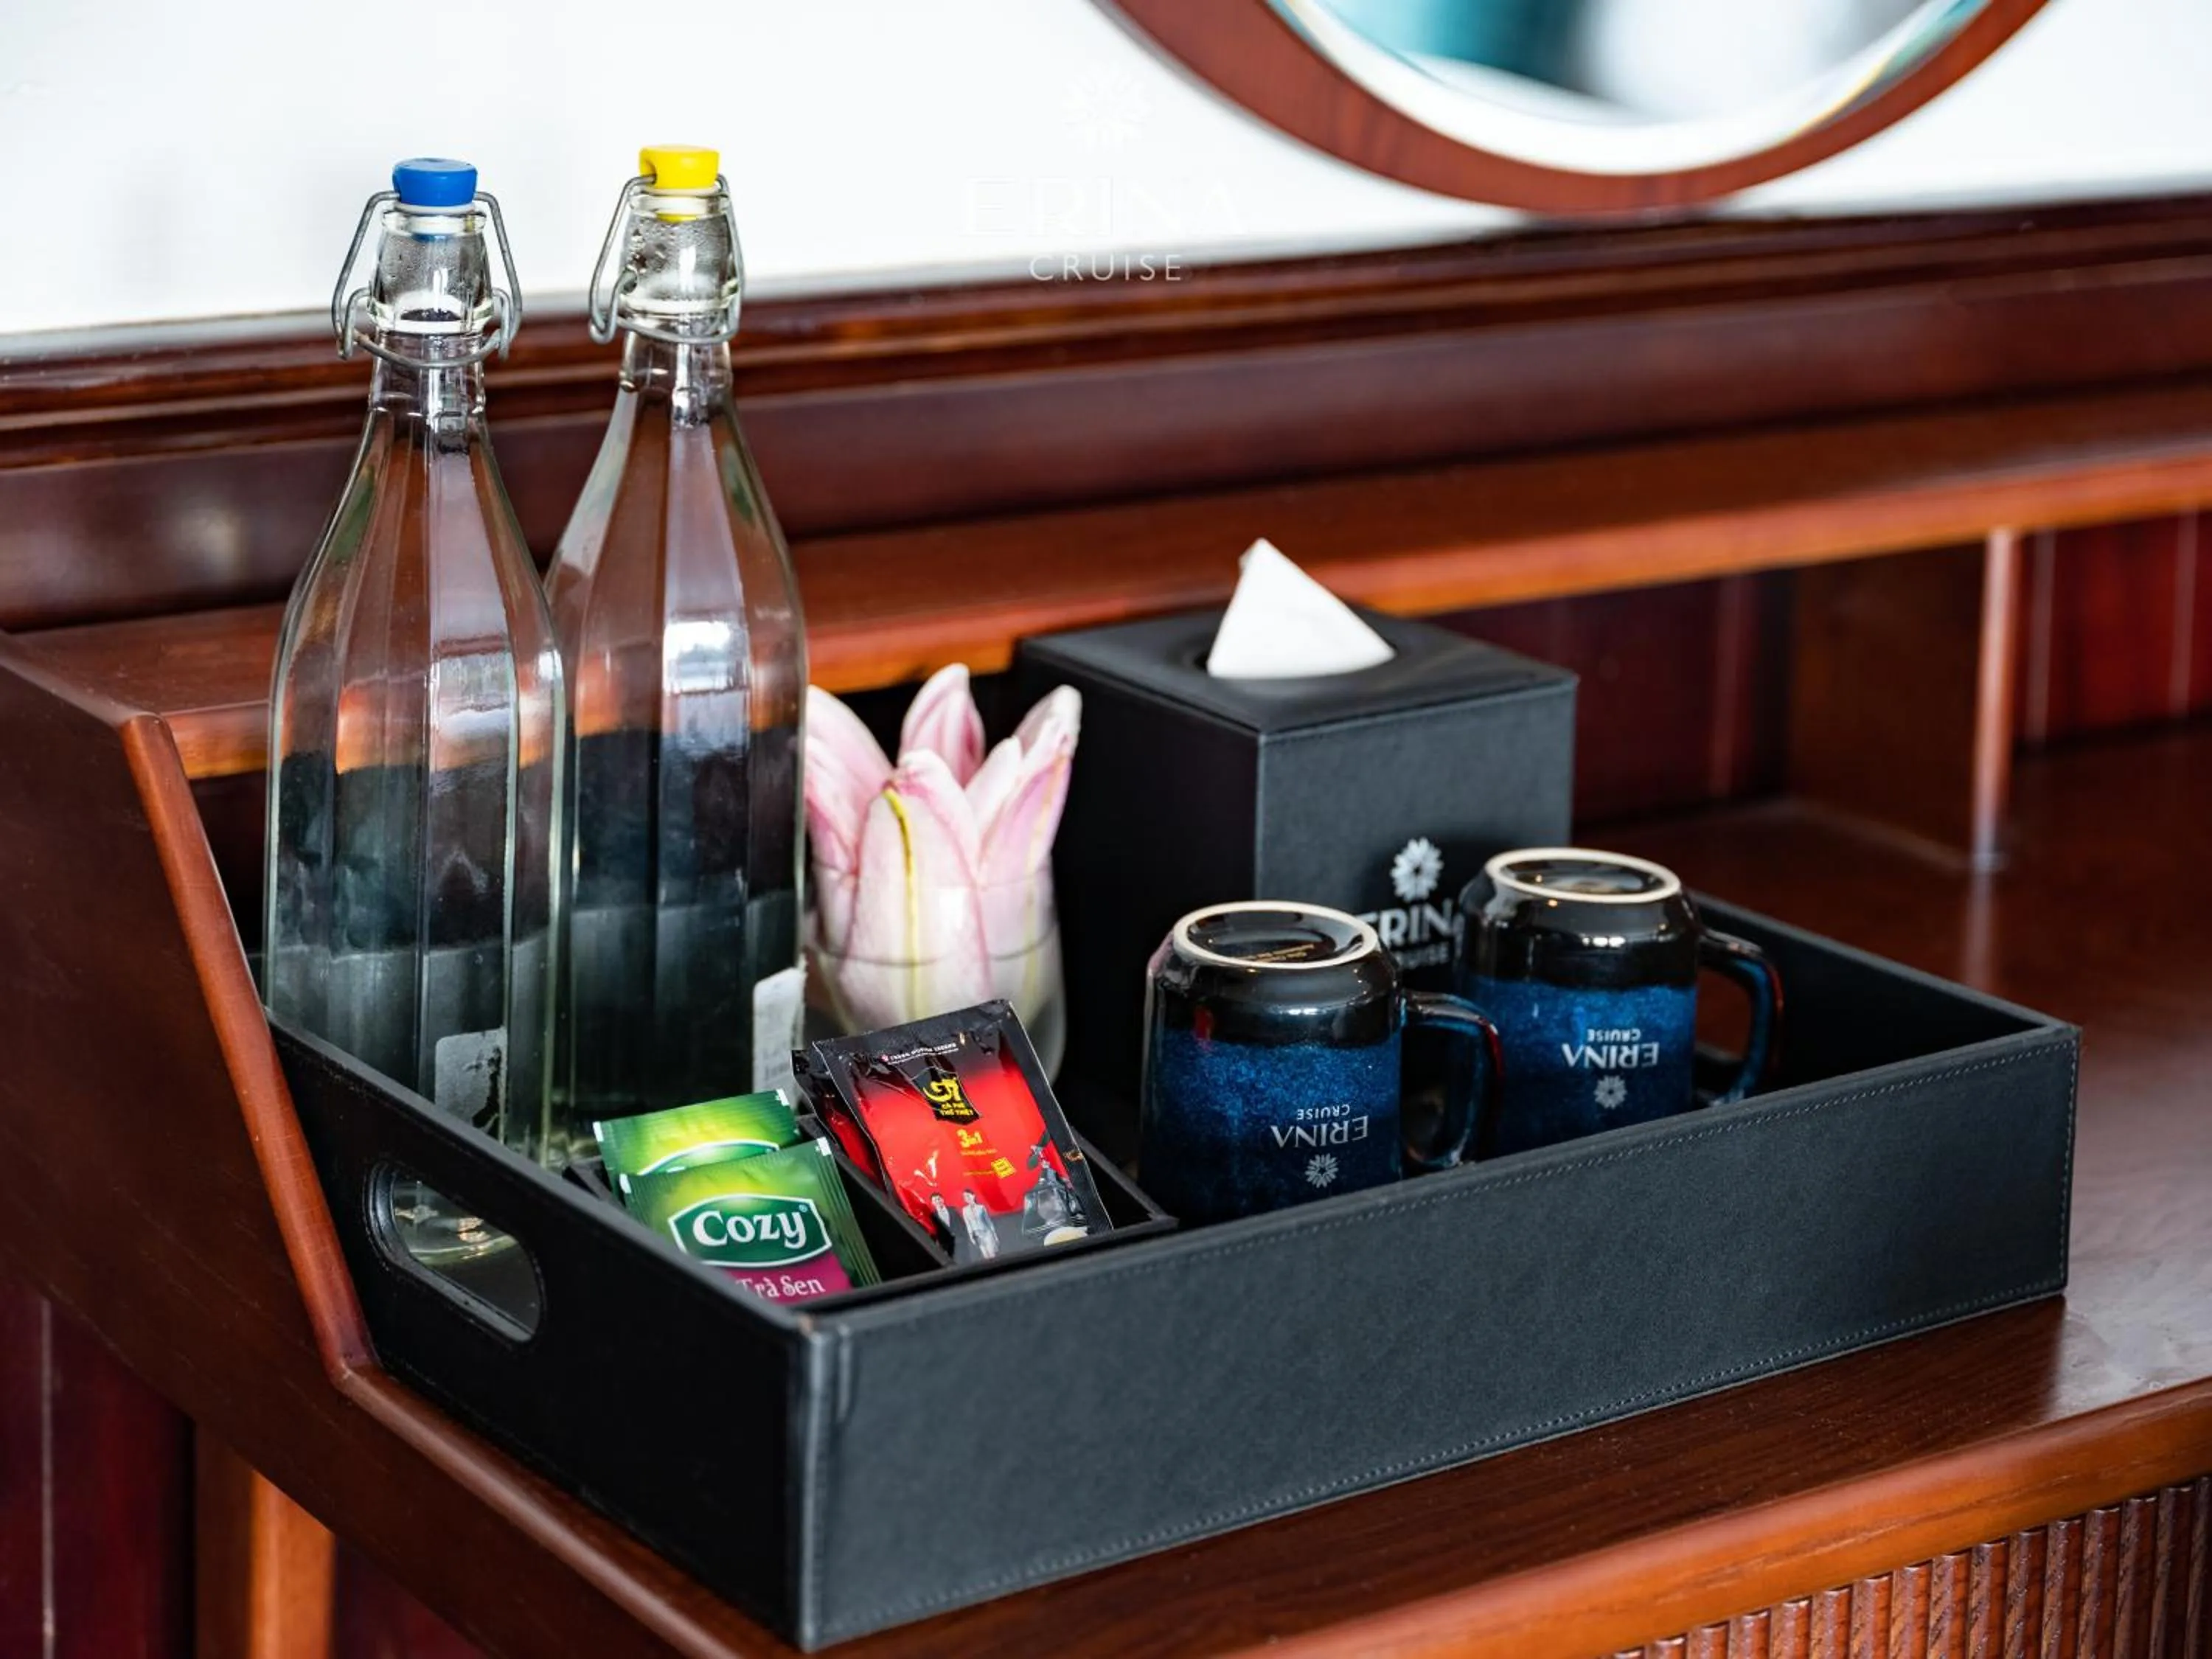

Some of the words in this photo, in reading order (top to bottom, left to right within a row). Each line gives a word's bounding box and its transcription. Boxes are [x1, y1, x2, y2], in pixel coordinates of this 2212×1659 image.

[1357, 897, 1453, 947] RIN
[1586, 1029, 1642, 1043] CRUISE
[1561, 1042, 1660, 1069] ERINA
[1297, 1104, 1351, 1120] CRUISE
[1270, 1115, 1369, 1148] ERINA
[692, 1210, 807, 1250] Cozy
[780, 1275, 826, 1297] Sen
